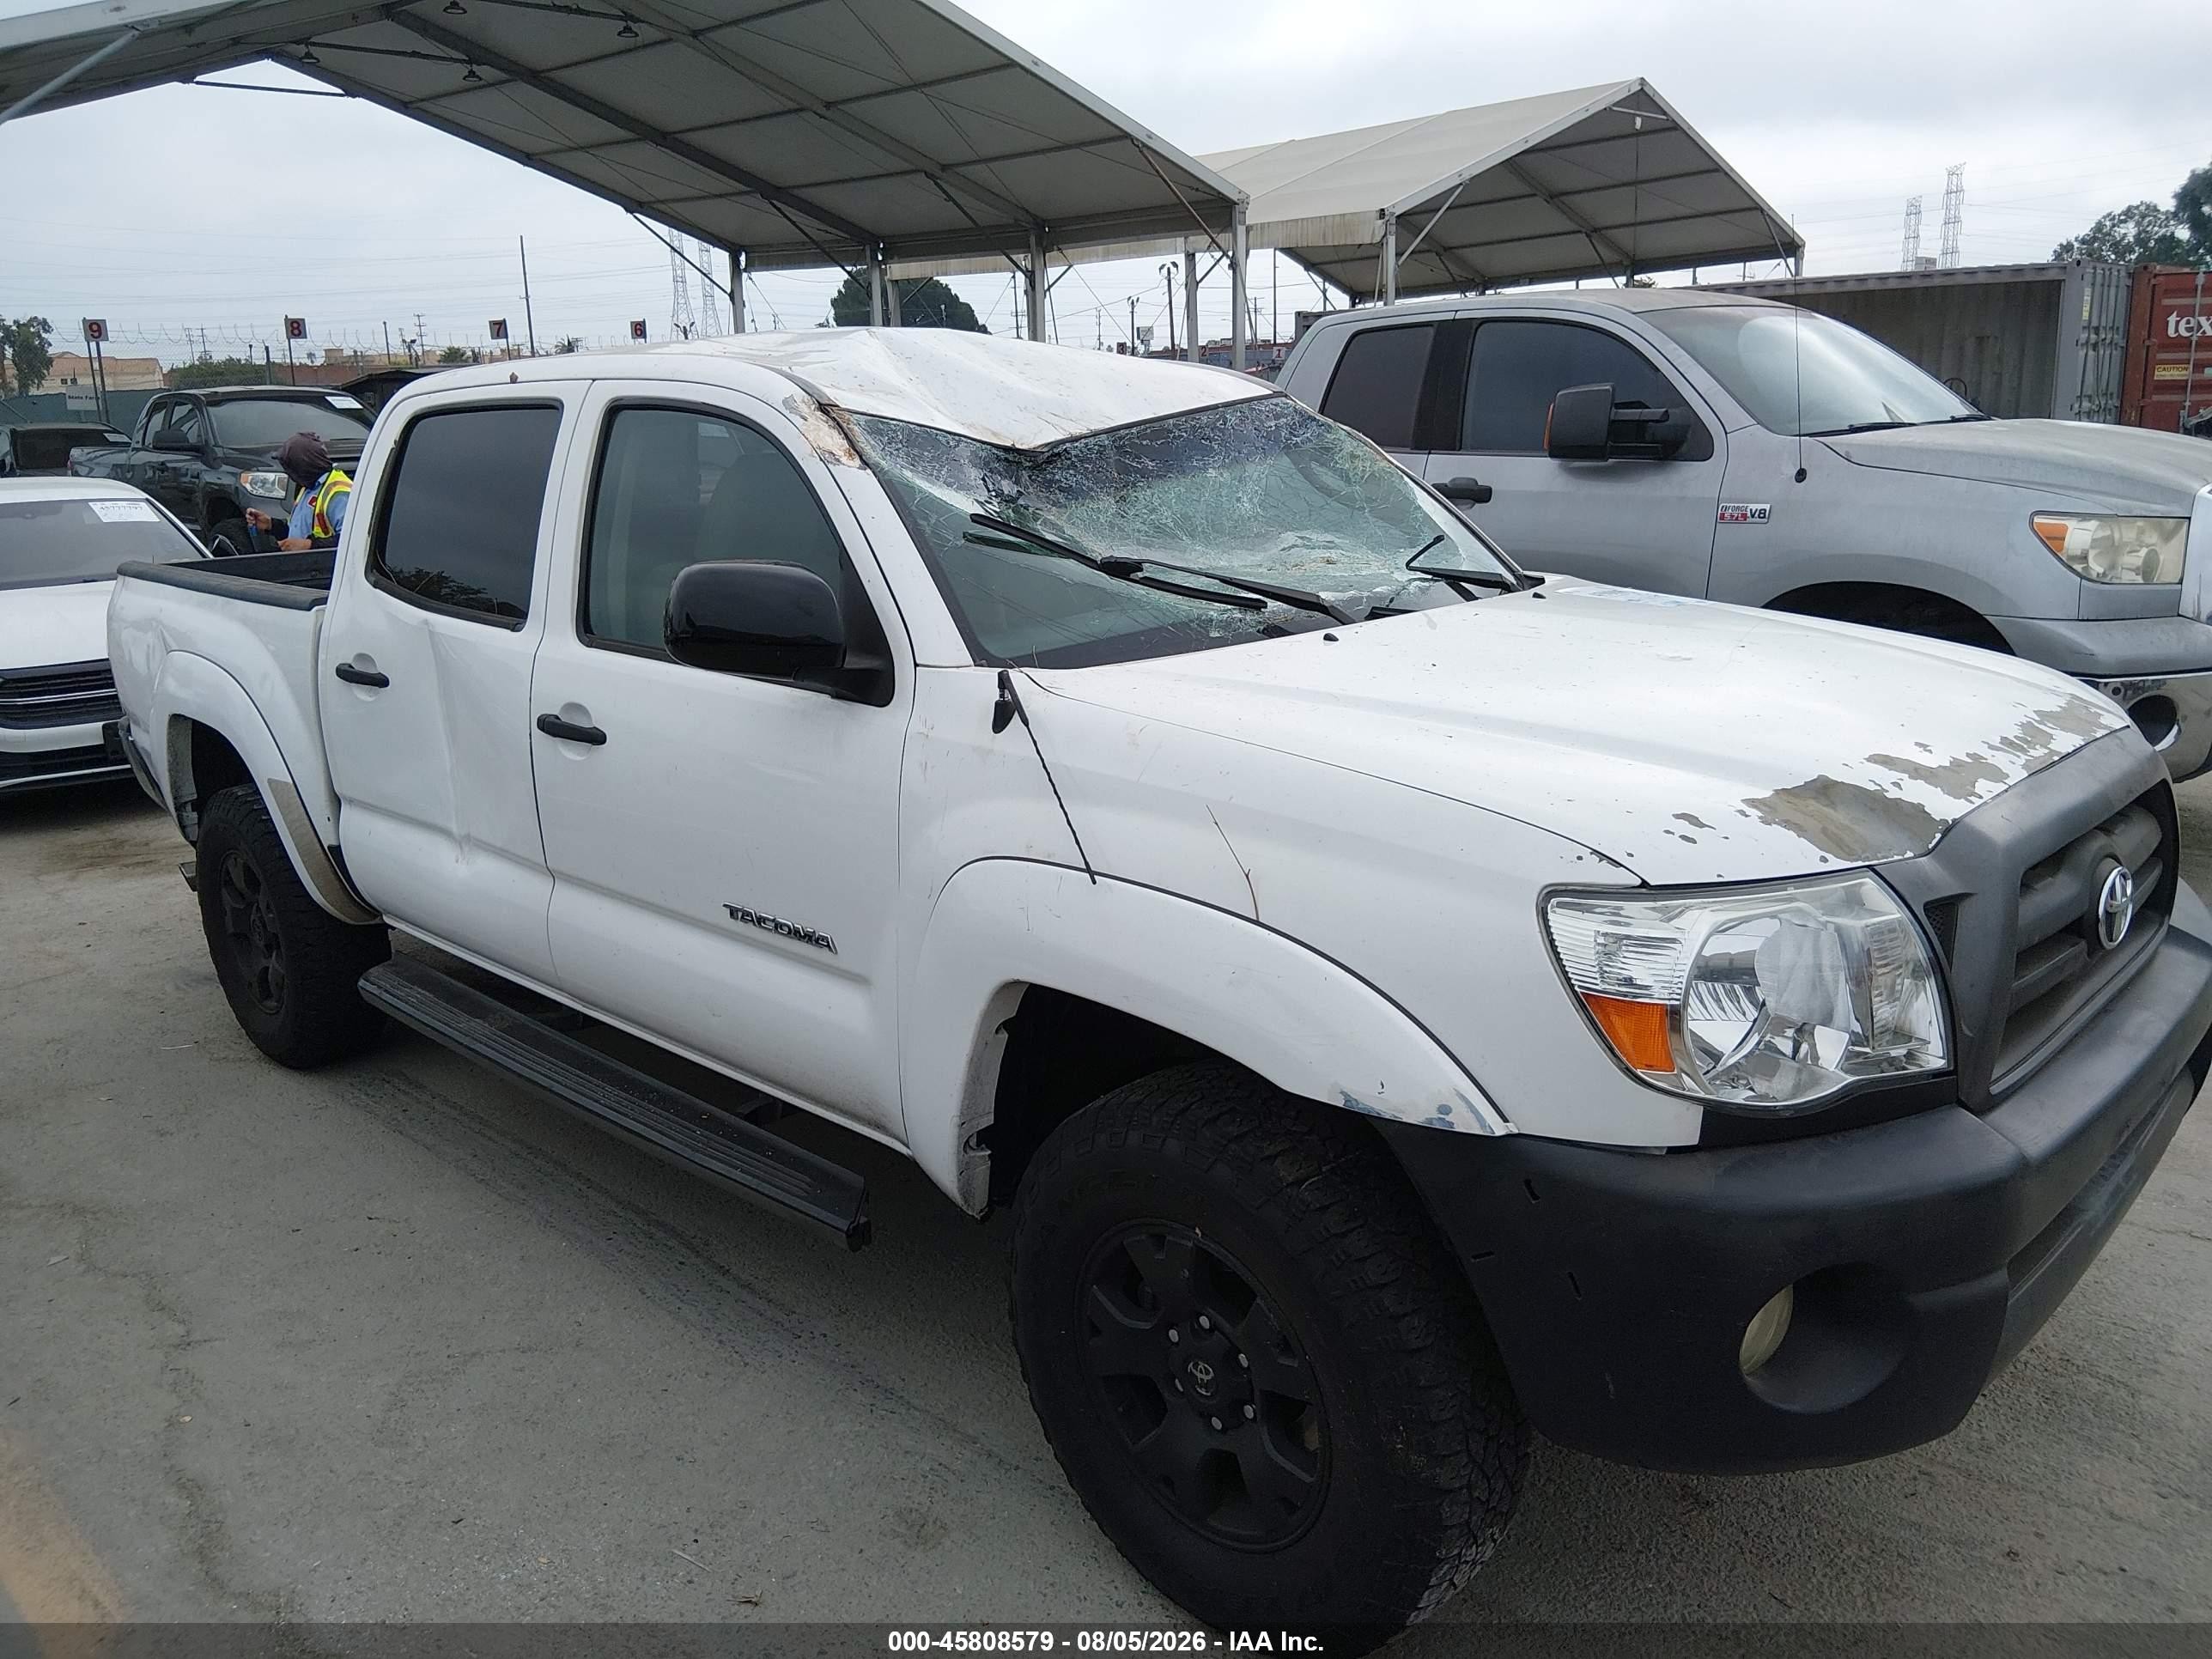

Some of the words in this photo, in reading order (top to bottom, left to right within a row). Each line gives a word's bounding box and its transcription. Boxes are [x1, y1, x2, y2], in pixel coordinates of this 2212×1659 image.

[88, 321, 103, 339] 9
[289, 319, 302, 337] 8
[492, 322, 503, 337] 7
[634, 322, 645, 337] 6
[1119, 343, 1125, 355] 3
[1200, 346, 1206, 357] 2
[1275, 349, 1282, 358] 1
[722, 902, 838, 954] TACOMA
